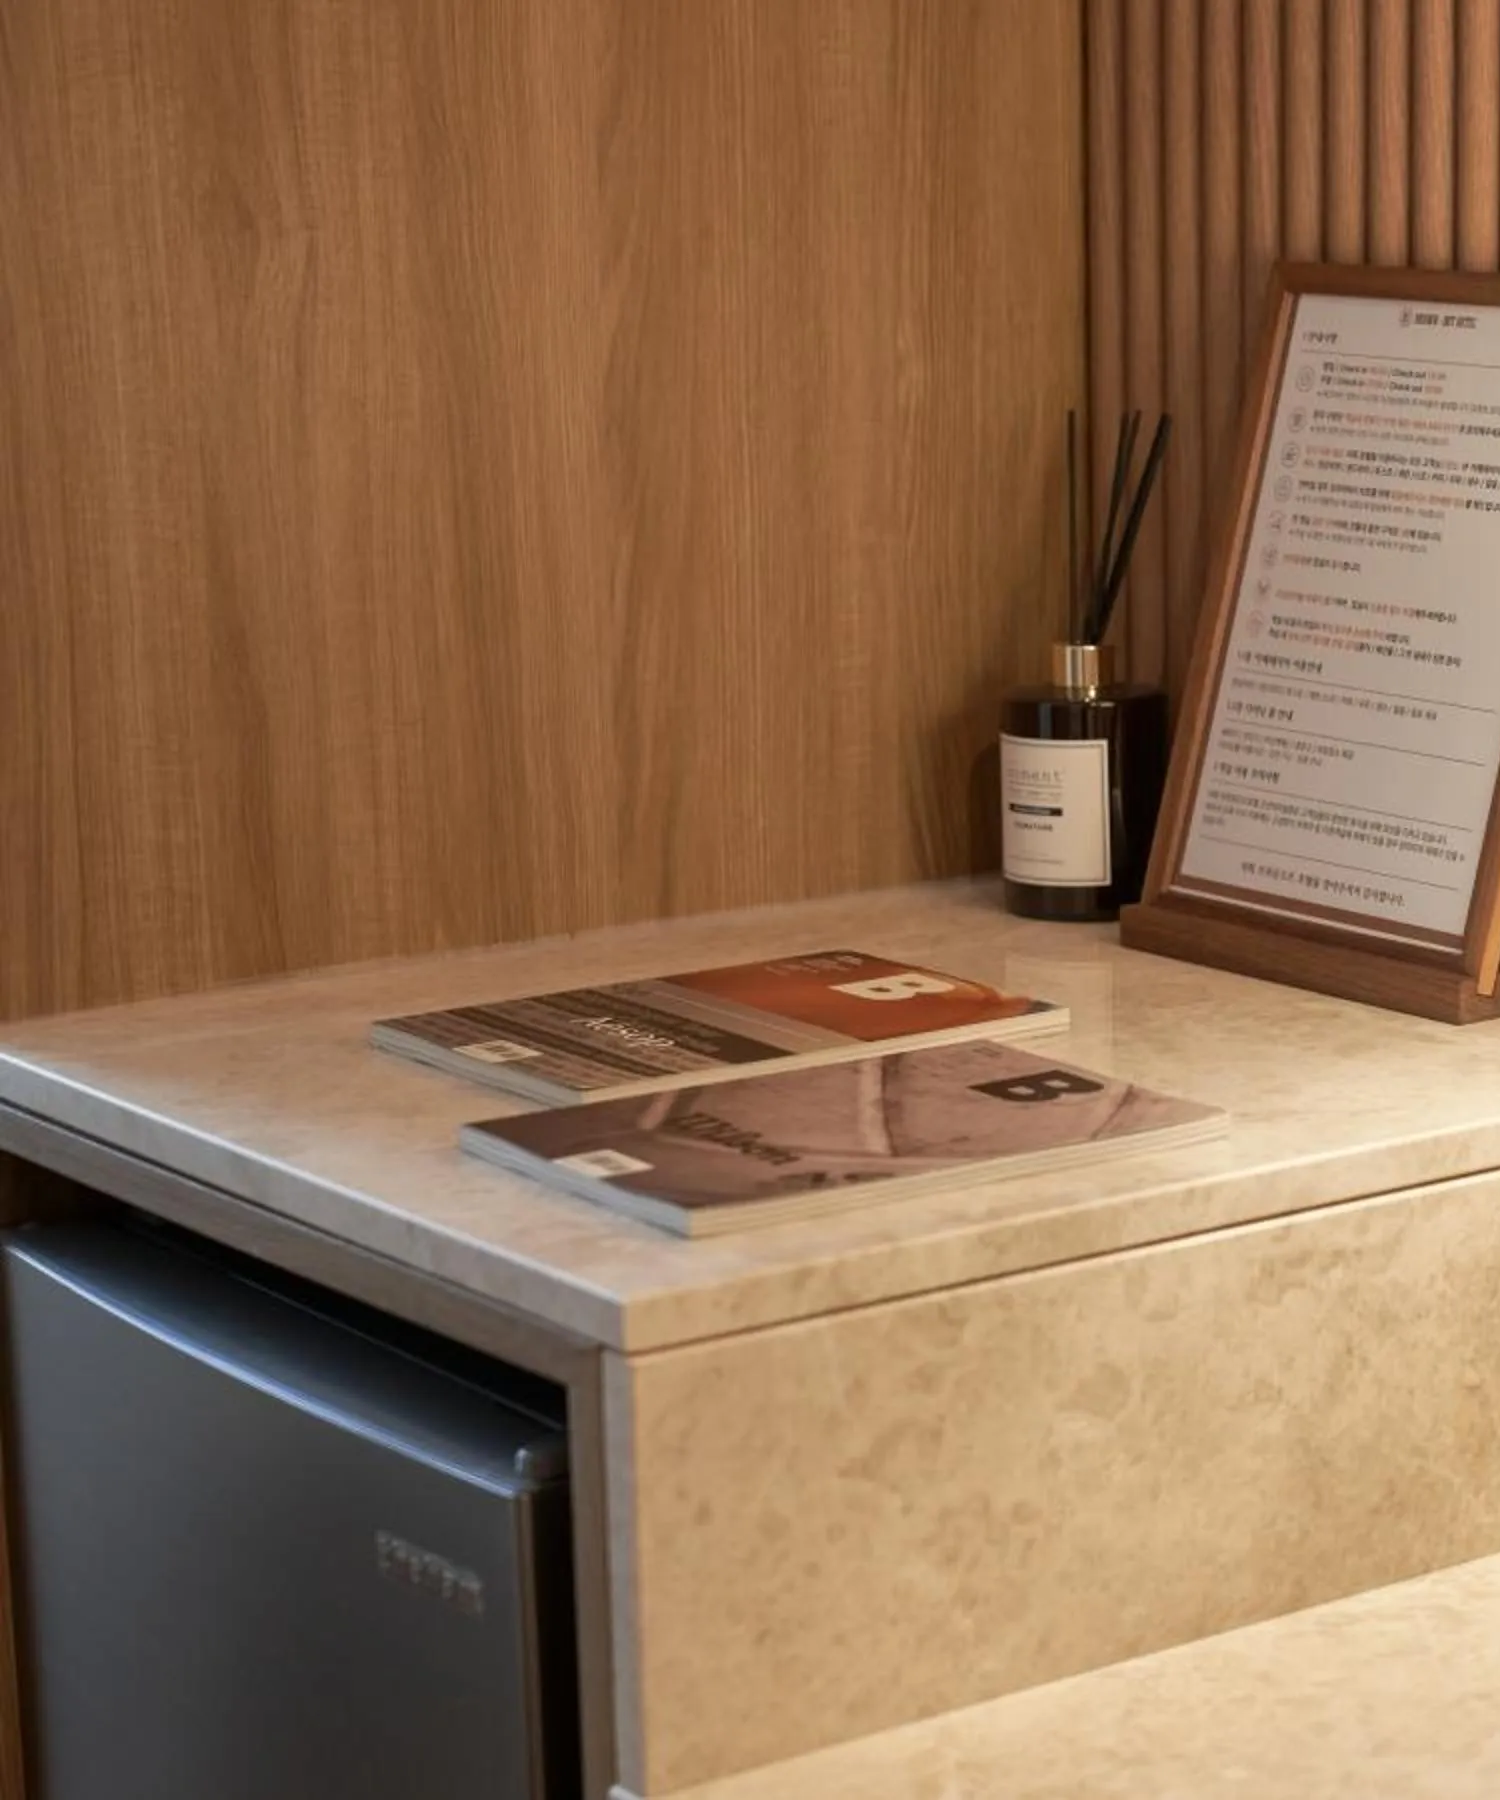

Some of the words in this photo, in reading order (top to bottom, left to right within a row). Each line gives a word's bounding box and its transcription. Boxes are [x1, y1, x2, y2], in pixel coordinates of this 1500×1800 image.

[828, 974, 955, 1001] B
[570, 1016, 675, 1048] Aesop
[966, 1069, 1104, 1103] B
